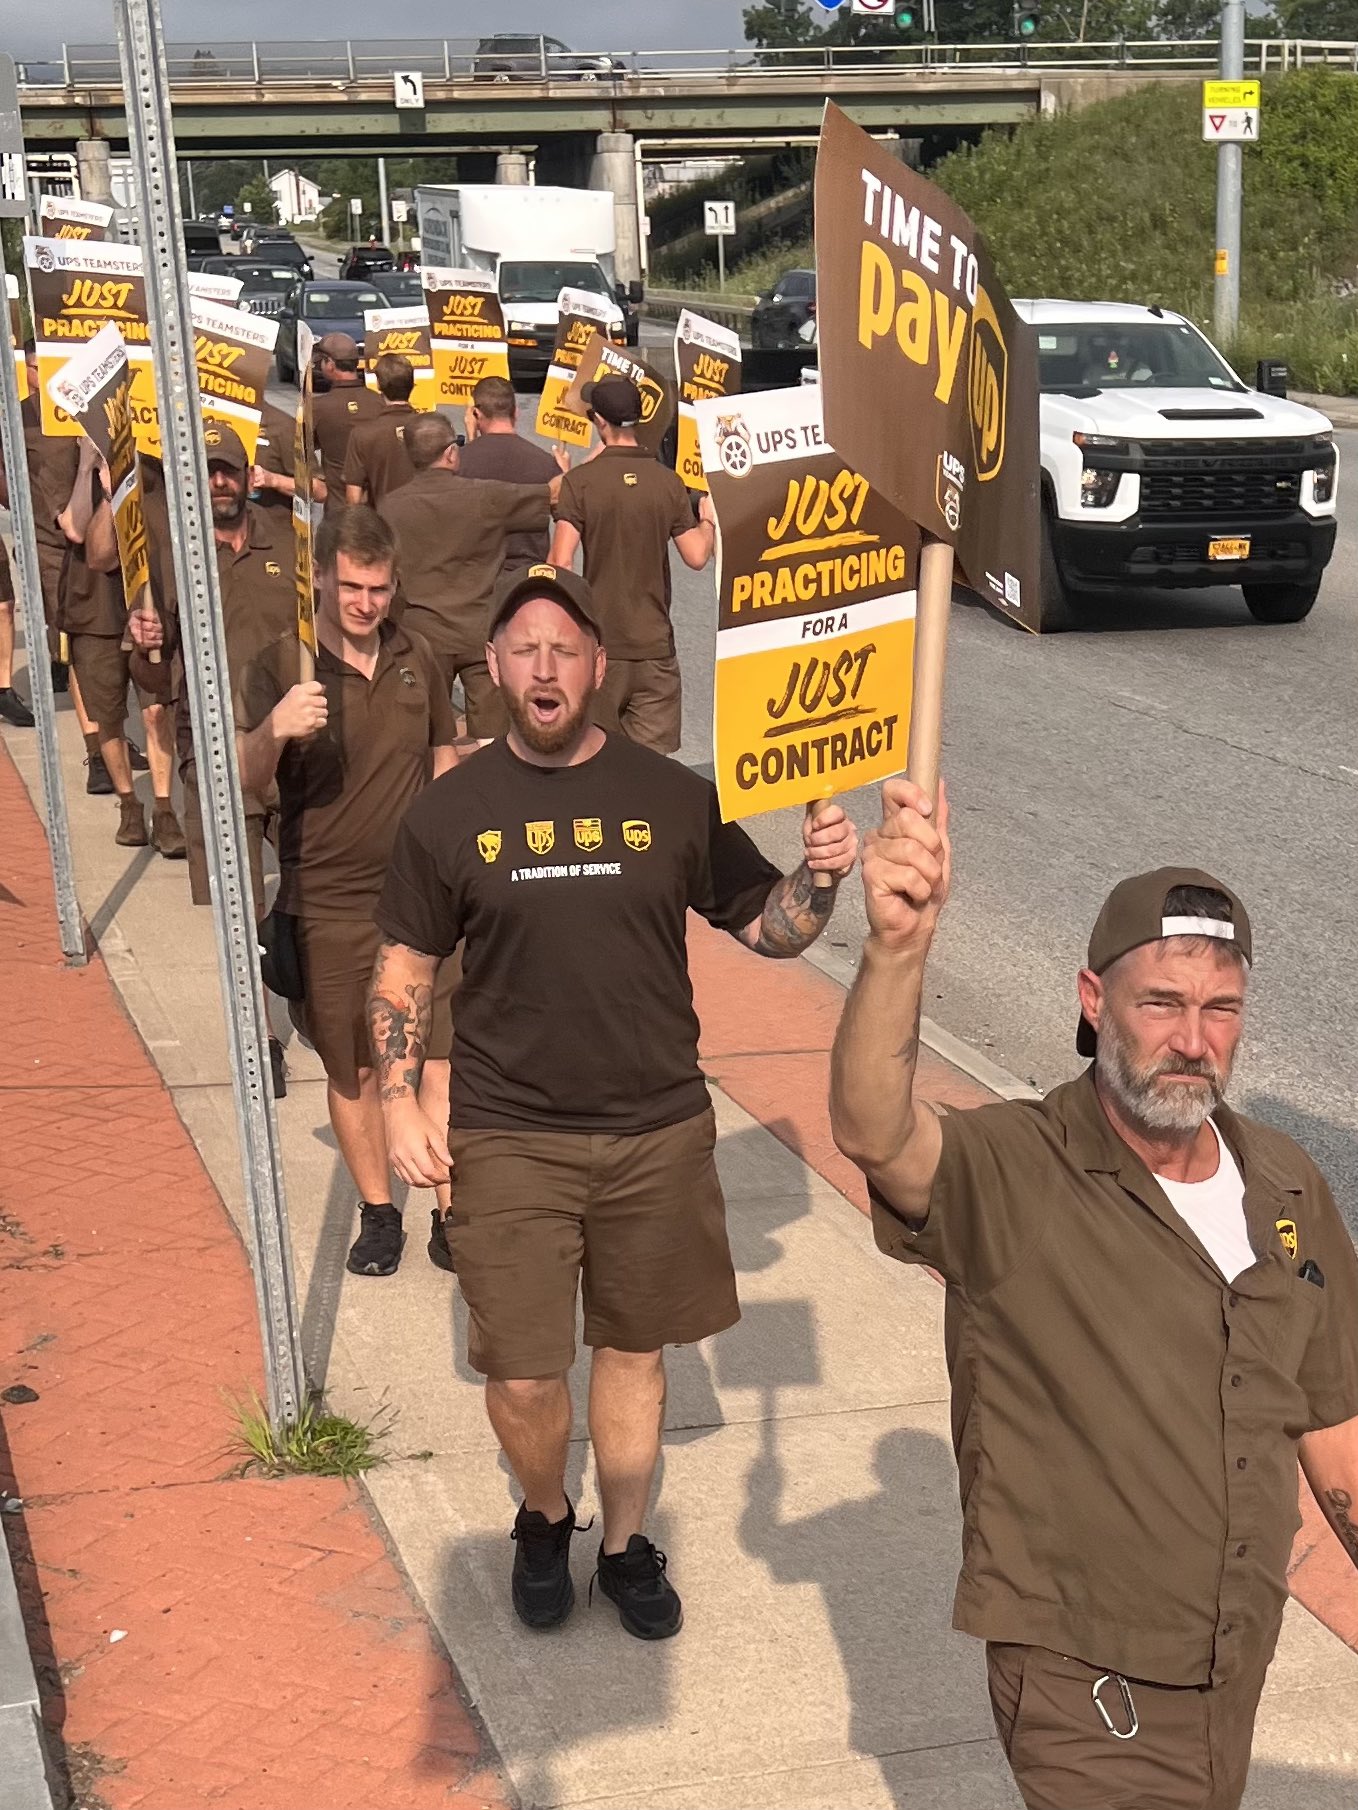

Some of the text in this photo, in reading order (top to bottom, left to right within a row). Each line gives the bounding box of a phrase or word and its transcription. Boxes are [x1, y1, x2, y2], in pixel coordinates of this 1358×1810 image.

[55, 224, 92, 240] JUST
[860, 168, 980, 300] TIME TO
[57, 256, 81, 267] UPS
[62, 279, 135, 308] JUST
[442, 295, 485, 316] JUST
[206, 317, 267, 344] TEAMSTERS
[433, 322, 502, 339] PRACTICING
[858, 240, 966, 404] pay
[194, 336, 246, 369] UST
[379, 331, 421, 350] JUST
[448, 356, 488, 375] JUST
[601, 346, 631, 374] TIME
[630, 364, 645, 383] TO
[693, 353, 729, 384] JUST
[199, 373, 257, 404] TICING
[542, 412, 588, 437] CONTRACT
[756, 427, 798, 454] UPS
[943, 451, 966, 484] UPS
[767, 469, 870, 541] JUST
[731, 544, 906, 613] PRACTICING
[801, 613, 848, 639] FOR A
[767, 643, 877, 721] JUST
[735, 714, 898, 790] CONTRACT
[624, 829, 649, 847] ups
[511, 862, 622, 882] A TRADITION OF SERVICE
